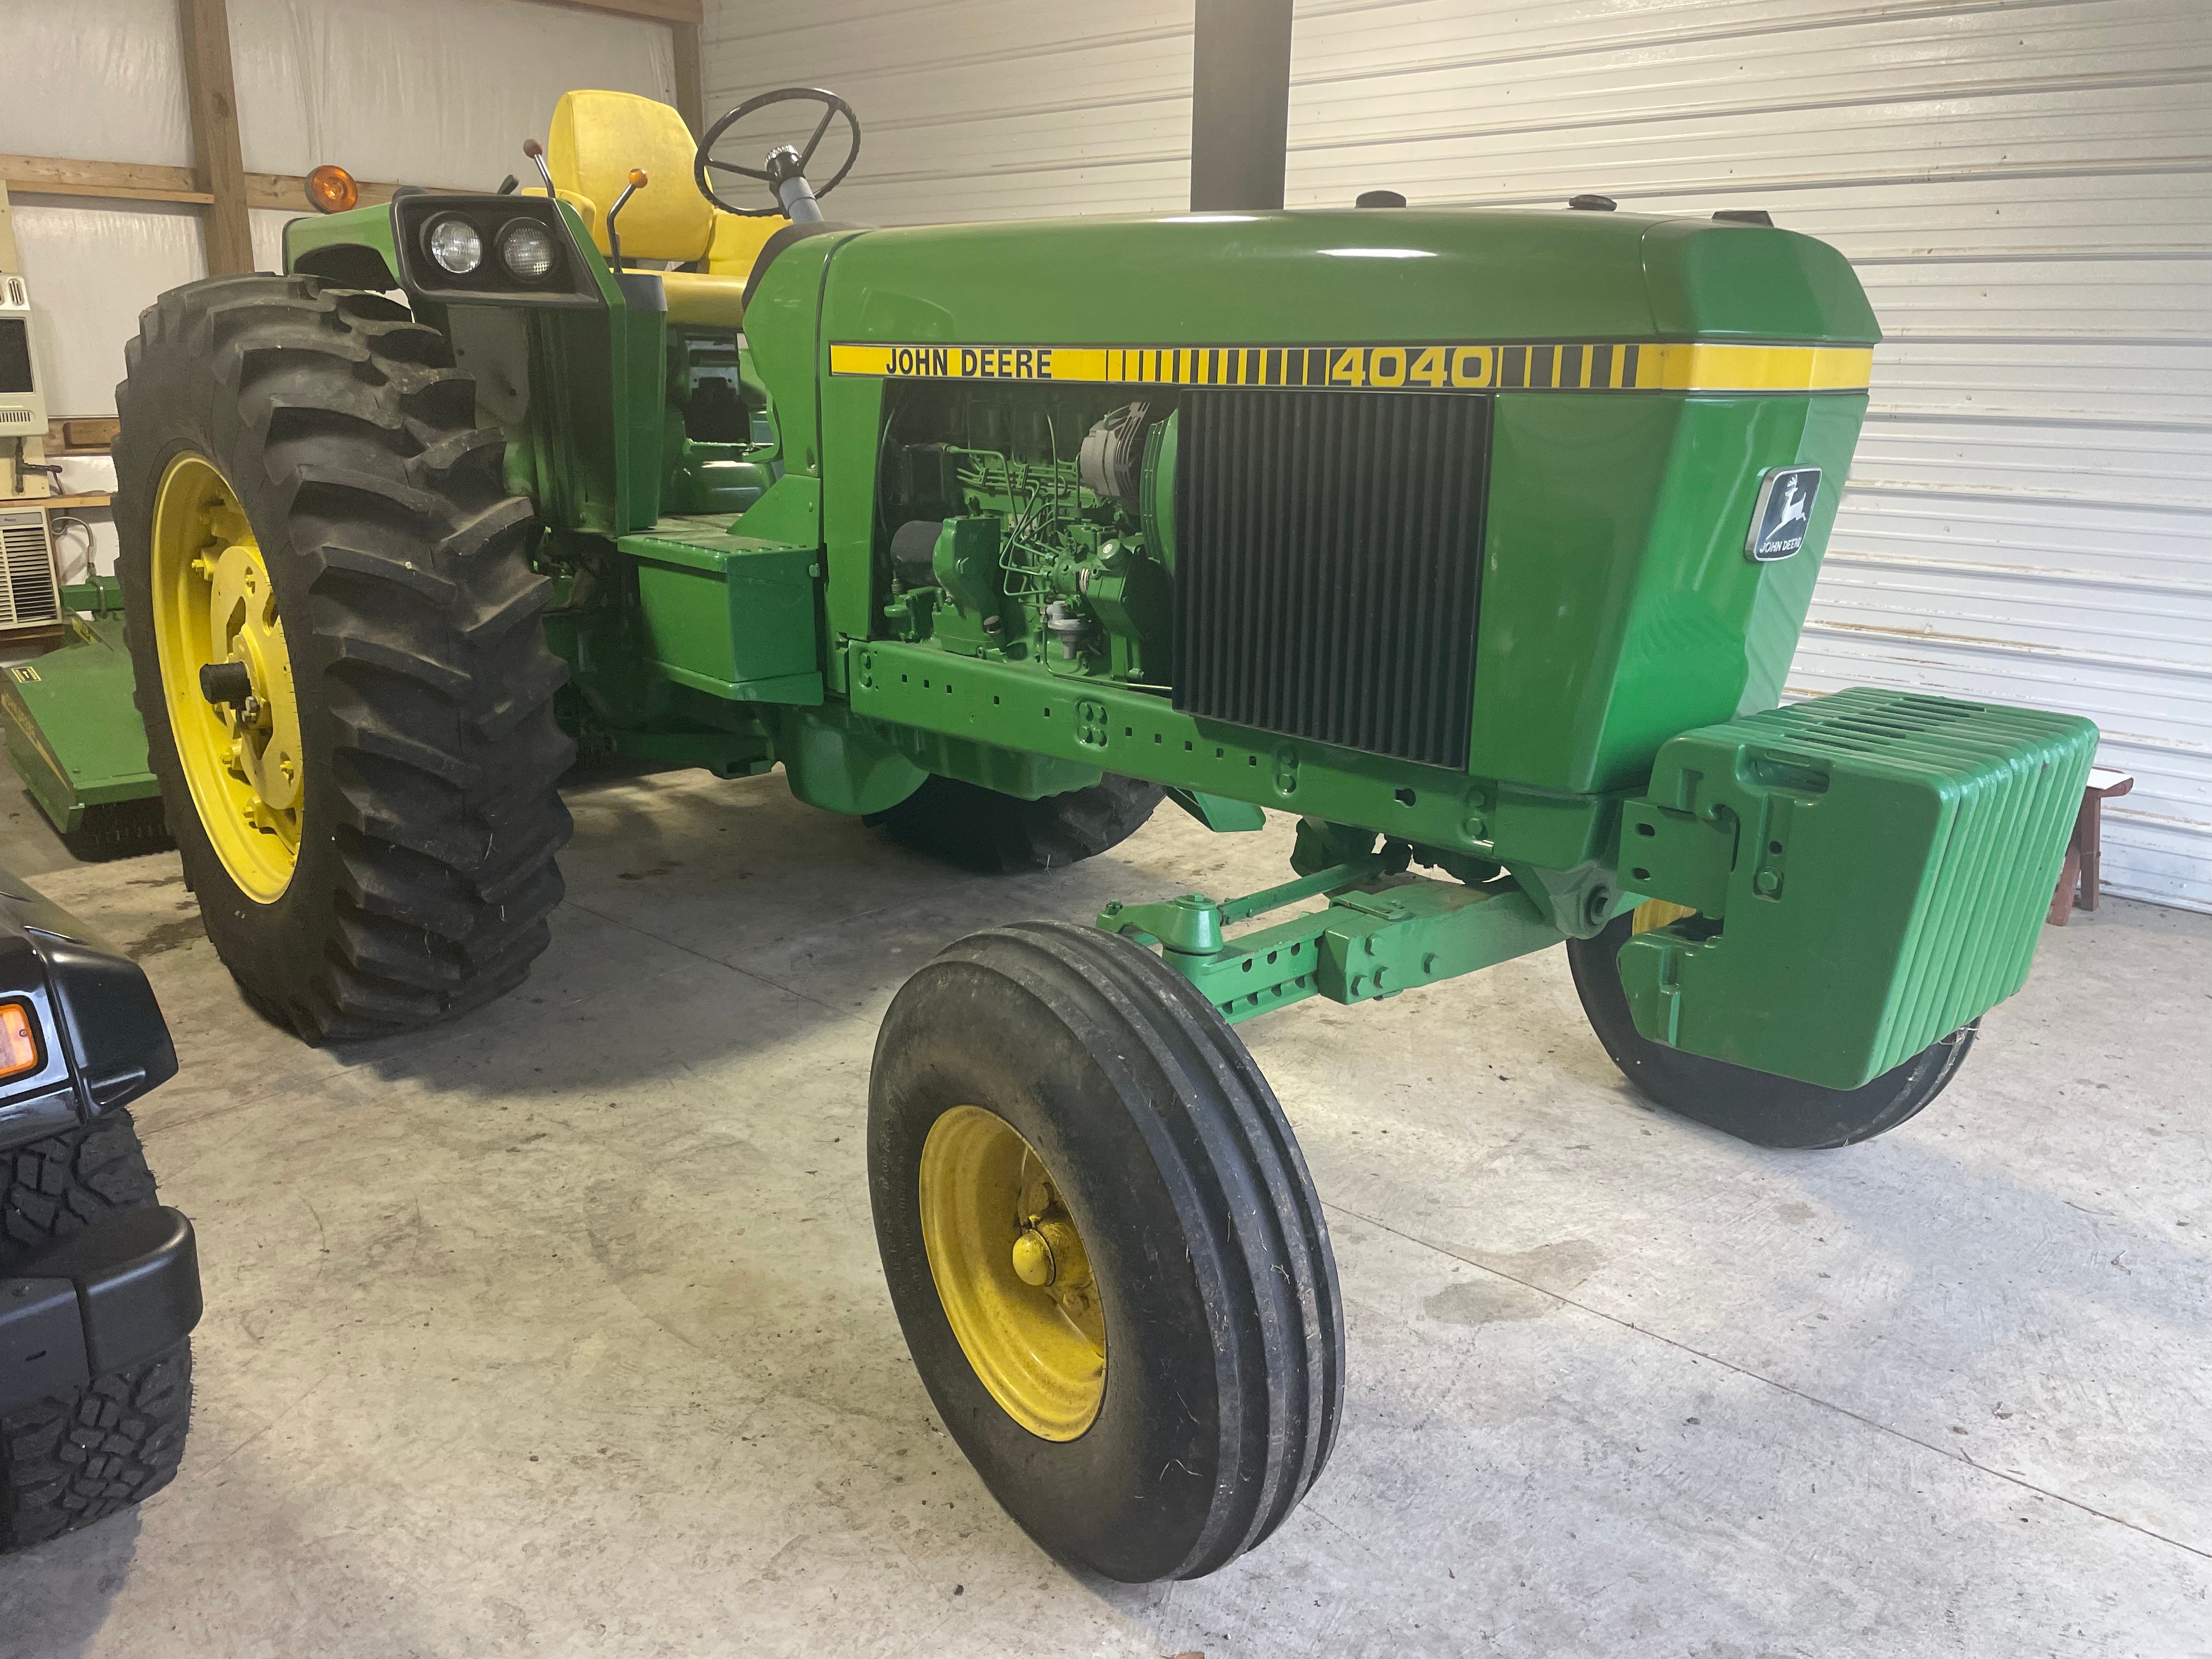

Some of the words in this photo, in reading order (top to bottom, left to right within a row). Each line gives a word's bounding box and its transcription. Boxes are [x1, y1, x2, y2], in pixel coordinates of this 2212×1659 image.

[886, 348, 948, 376] JOHN
[961, 349, 1052, 379] DEERE
[1331, 346, 1493, 388] 4040
[1759, 541, 1782, 554] JOHN
